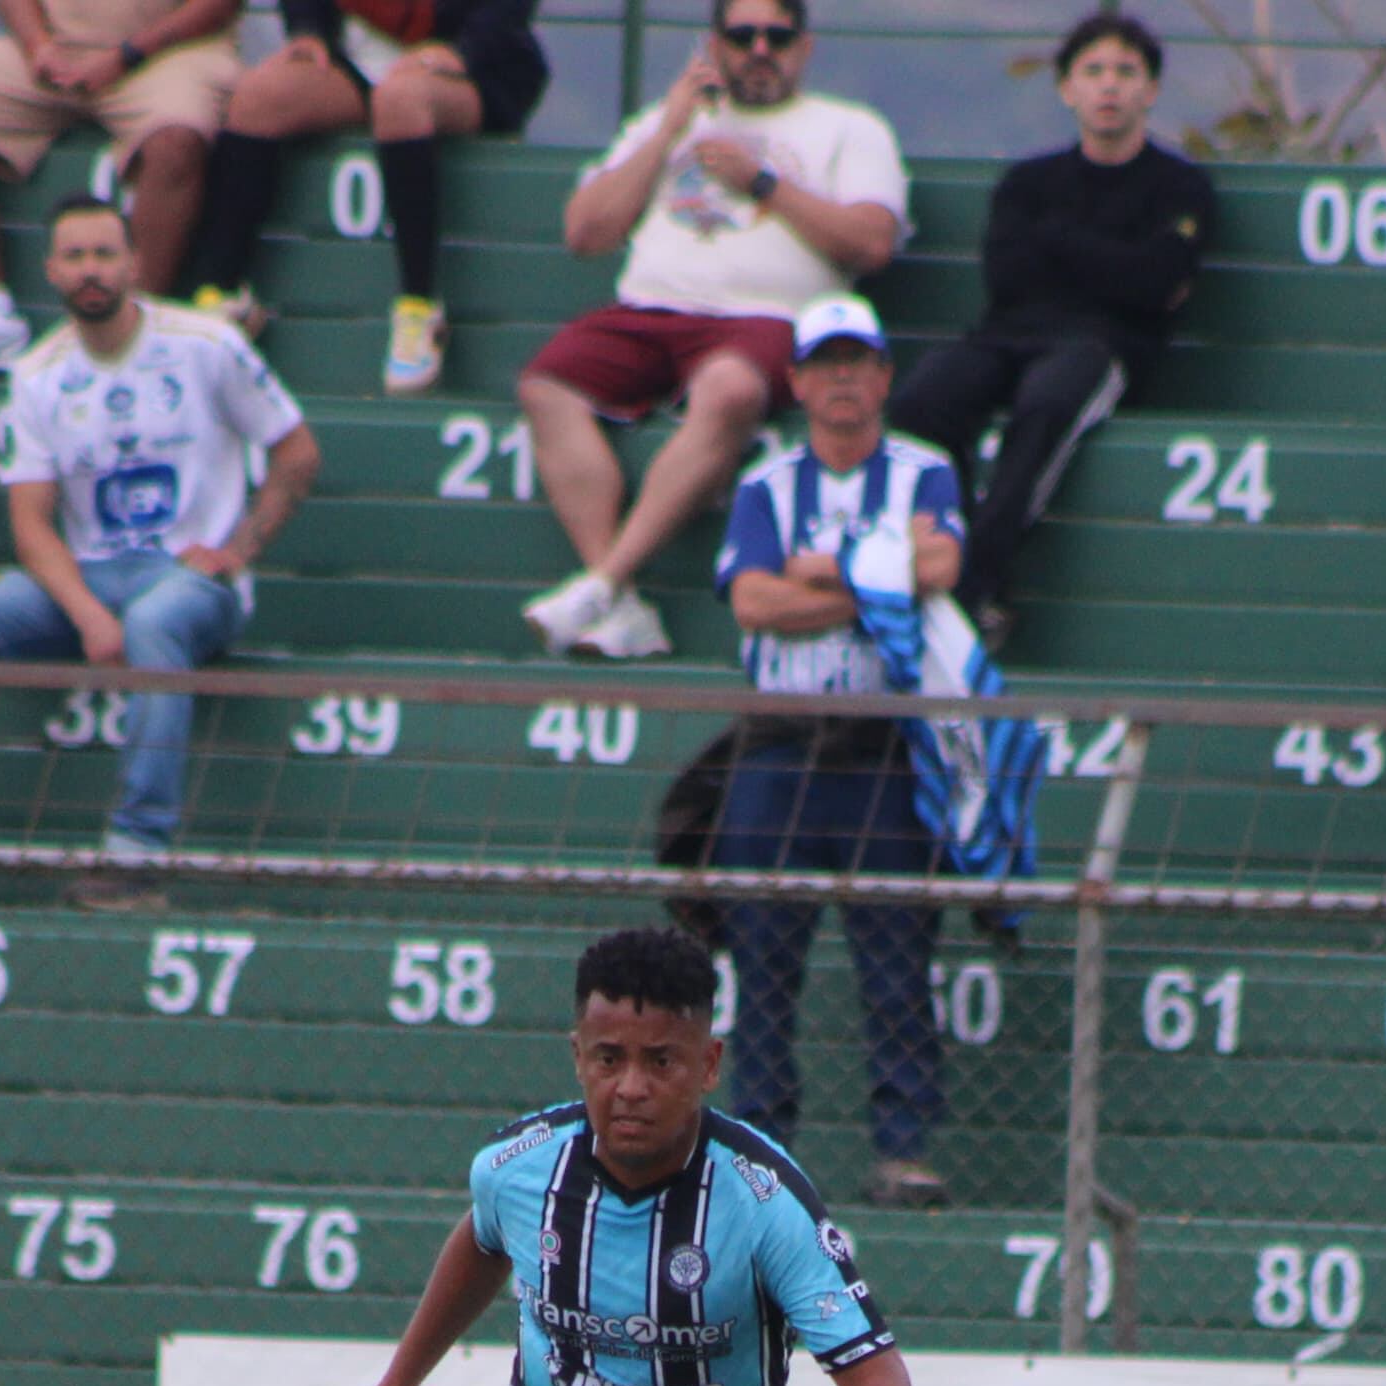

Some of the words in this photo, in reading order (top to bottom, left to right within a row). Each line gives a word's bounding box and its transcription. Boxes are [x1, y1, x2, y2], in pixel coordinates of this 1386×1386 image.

[439, 414, 533, 500] 21
[1163, 438, 1274, 523] 24
[292, 694, 400, 756] 39
[527, 699, 639, 764] 40
[1273, 720, 1386, 787] 43
[146, 931, 256, 1016] 57
[387, 939, 496, 1025] 58
[1141, 968, 1245, 1054] 61
[8, 1196, 116, 1283] 75
[251, 1205, 361, 1292] 76
[1252, 1245, 1363, 1330] 80
